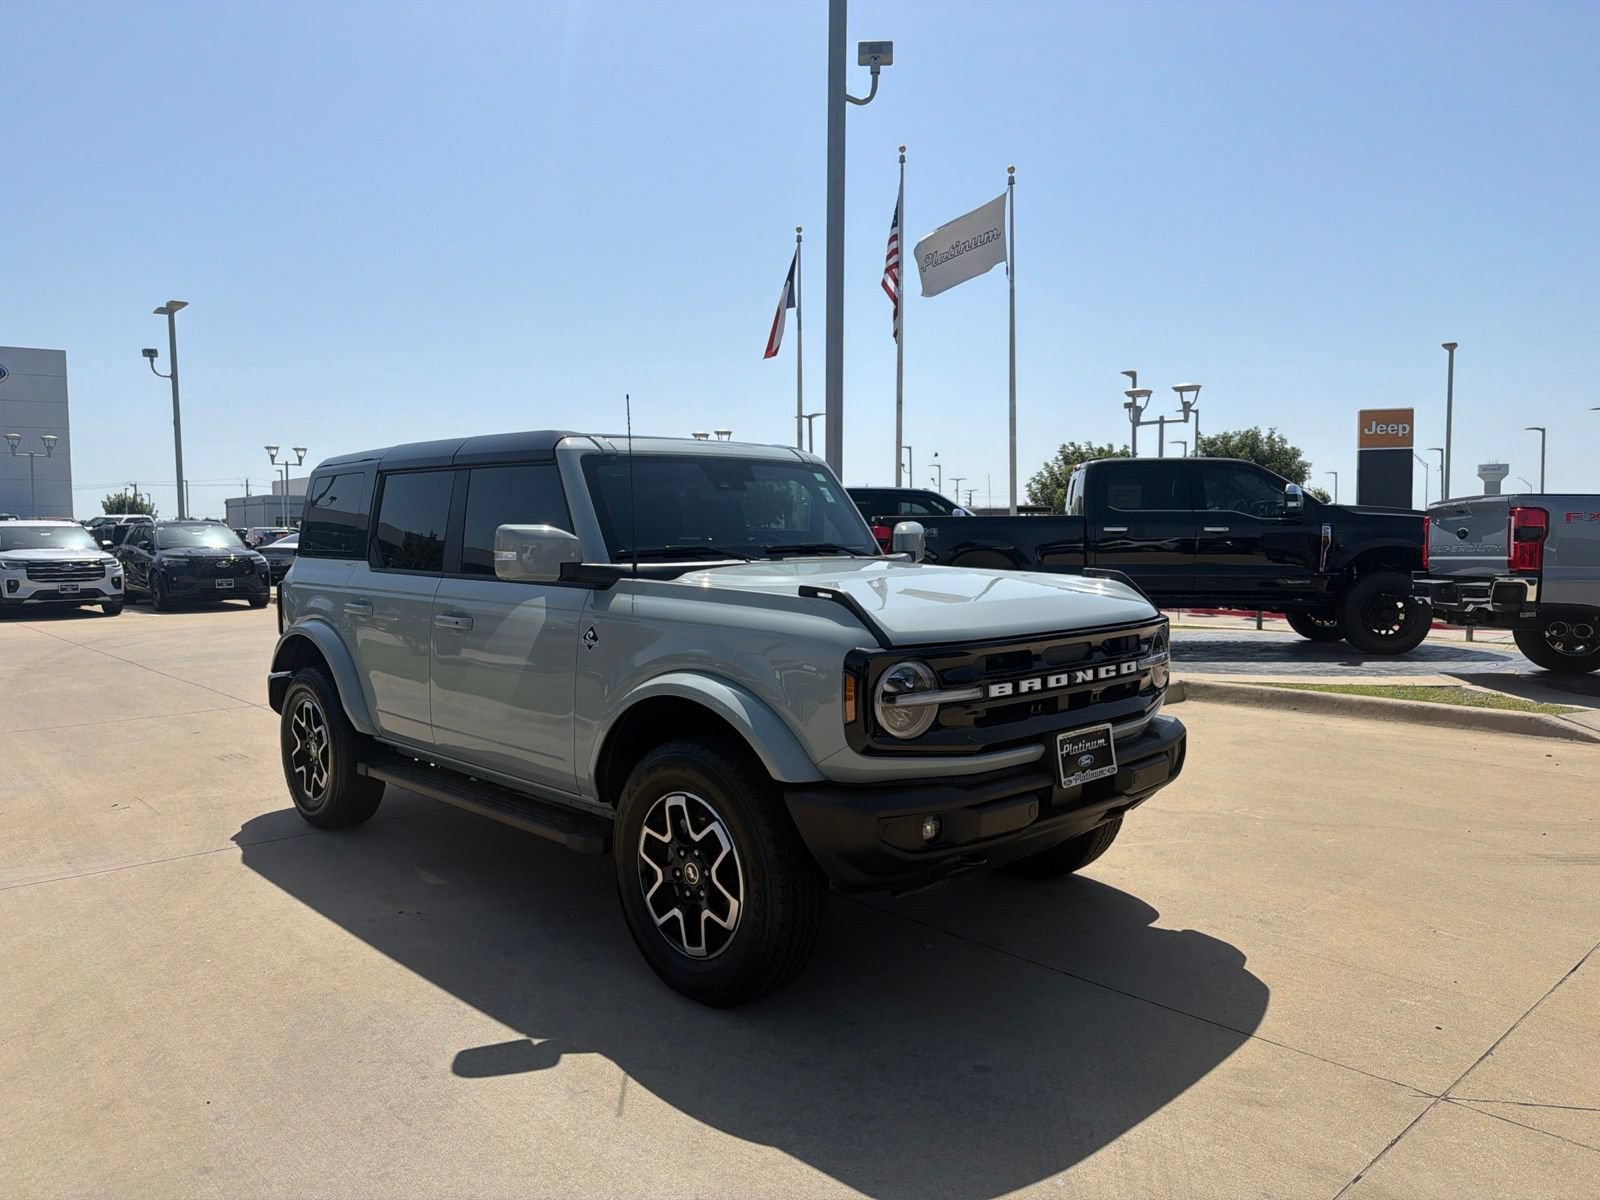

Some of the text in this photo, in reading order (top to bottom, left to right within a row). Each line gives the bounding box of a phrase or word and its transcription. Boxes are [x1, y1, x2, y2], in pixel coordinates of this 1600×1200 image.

[920, 228, 1001, 272] Platinum
[1364, 420, 1410, 437] Jeep
[1431, 543, 1503, 553] SUPER DUTY
[988, 661, 1137, 698] BRONCO
[1060, 738, 1108, 757] Platinum
[1073, 769, 1107, 784] Platinum
